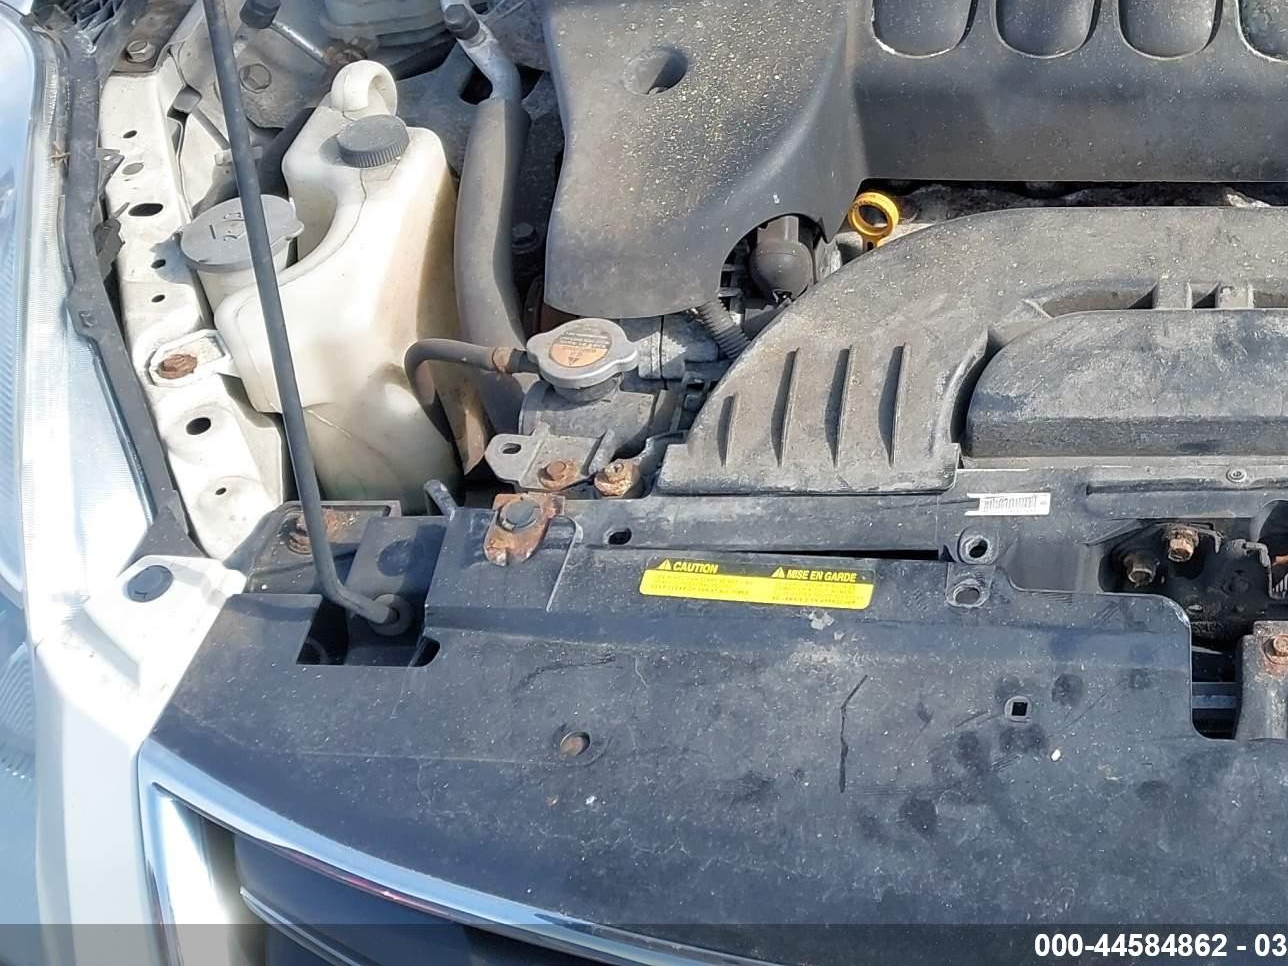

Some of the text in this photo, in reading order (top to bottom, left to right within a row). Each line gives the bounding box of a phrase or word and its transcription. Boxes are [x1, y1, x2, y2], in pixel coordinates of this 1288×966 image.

[673, 561, 719, 574] CAUTION
[786, 569, 858, 583] MISE EN GARDE
